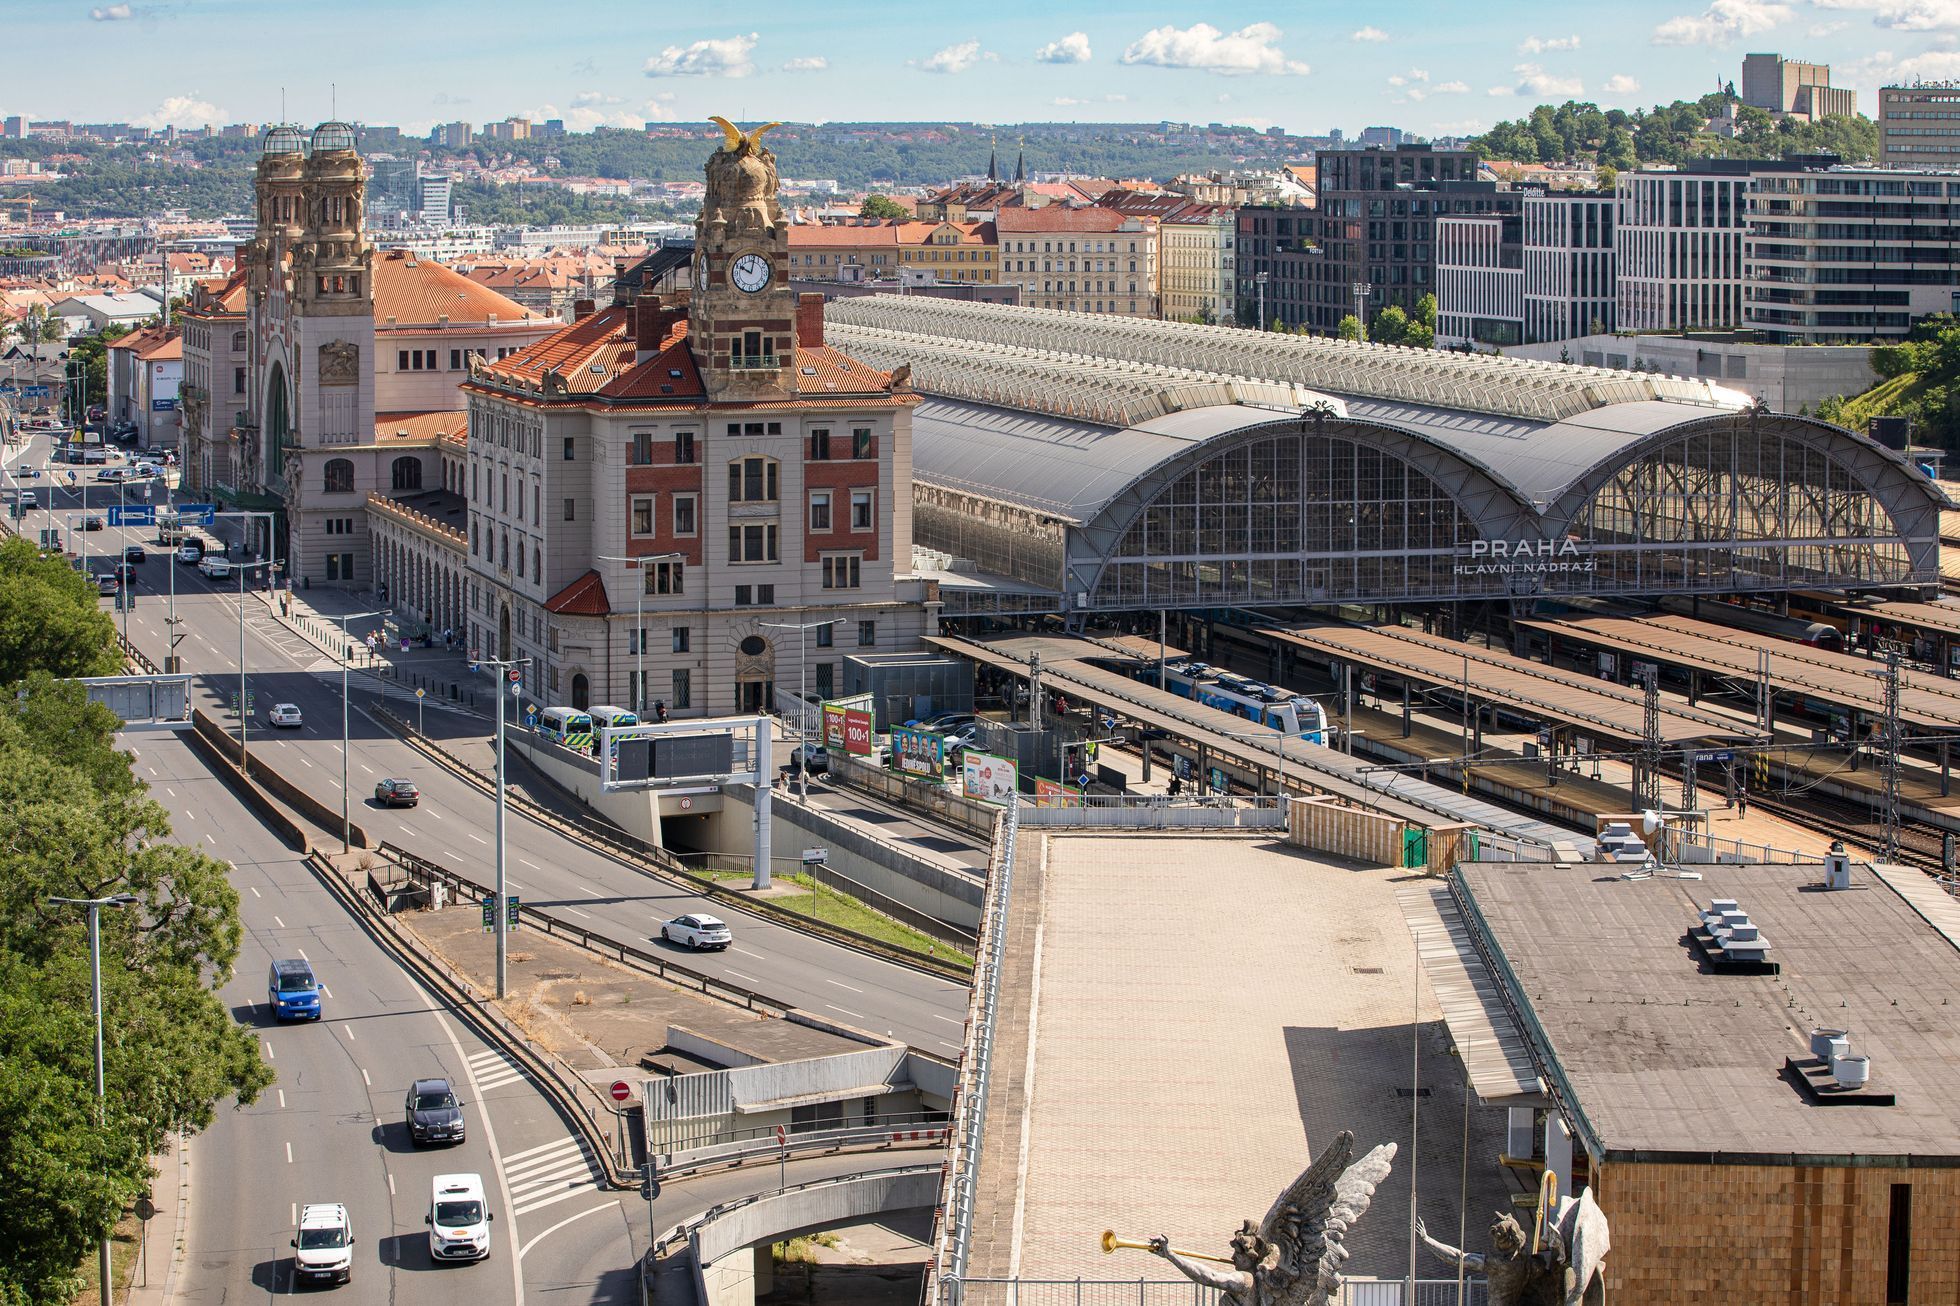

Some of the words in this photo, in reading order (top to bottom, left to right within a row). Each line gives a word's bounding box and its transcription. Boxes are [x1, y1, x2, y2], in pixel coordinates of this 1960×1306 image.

[1472, 539, 1579, 558] PRAHA
[1454, 561, 1515, 575] HLAVNÍ
[1524, 558, 1597, 573] NÁDRAŽÍ
[848, 726, 869, 742] 100+1
